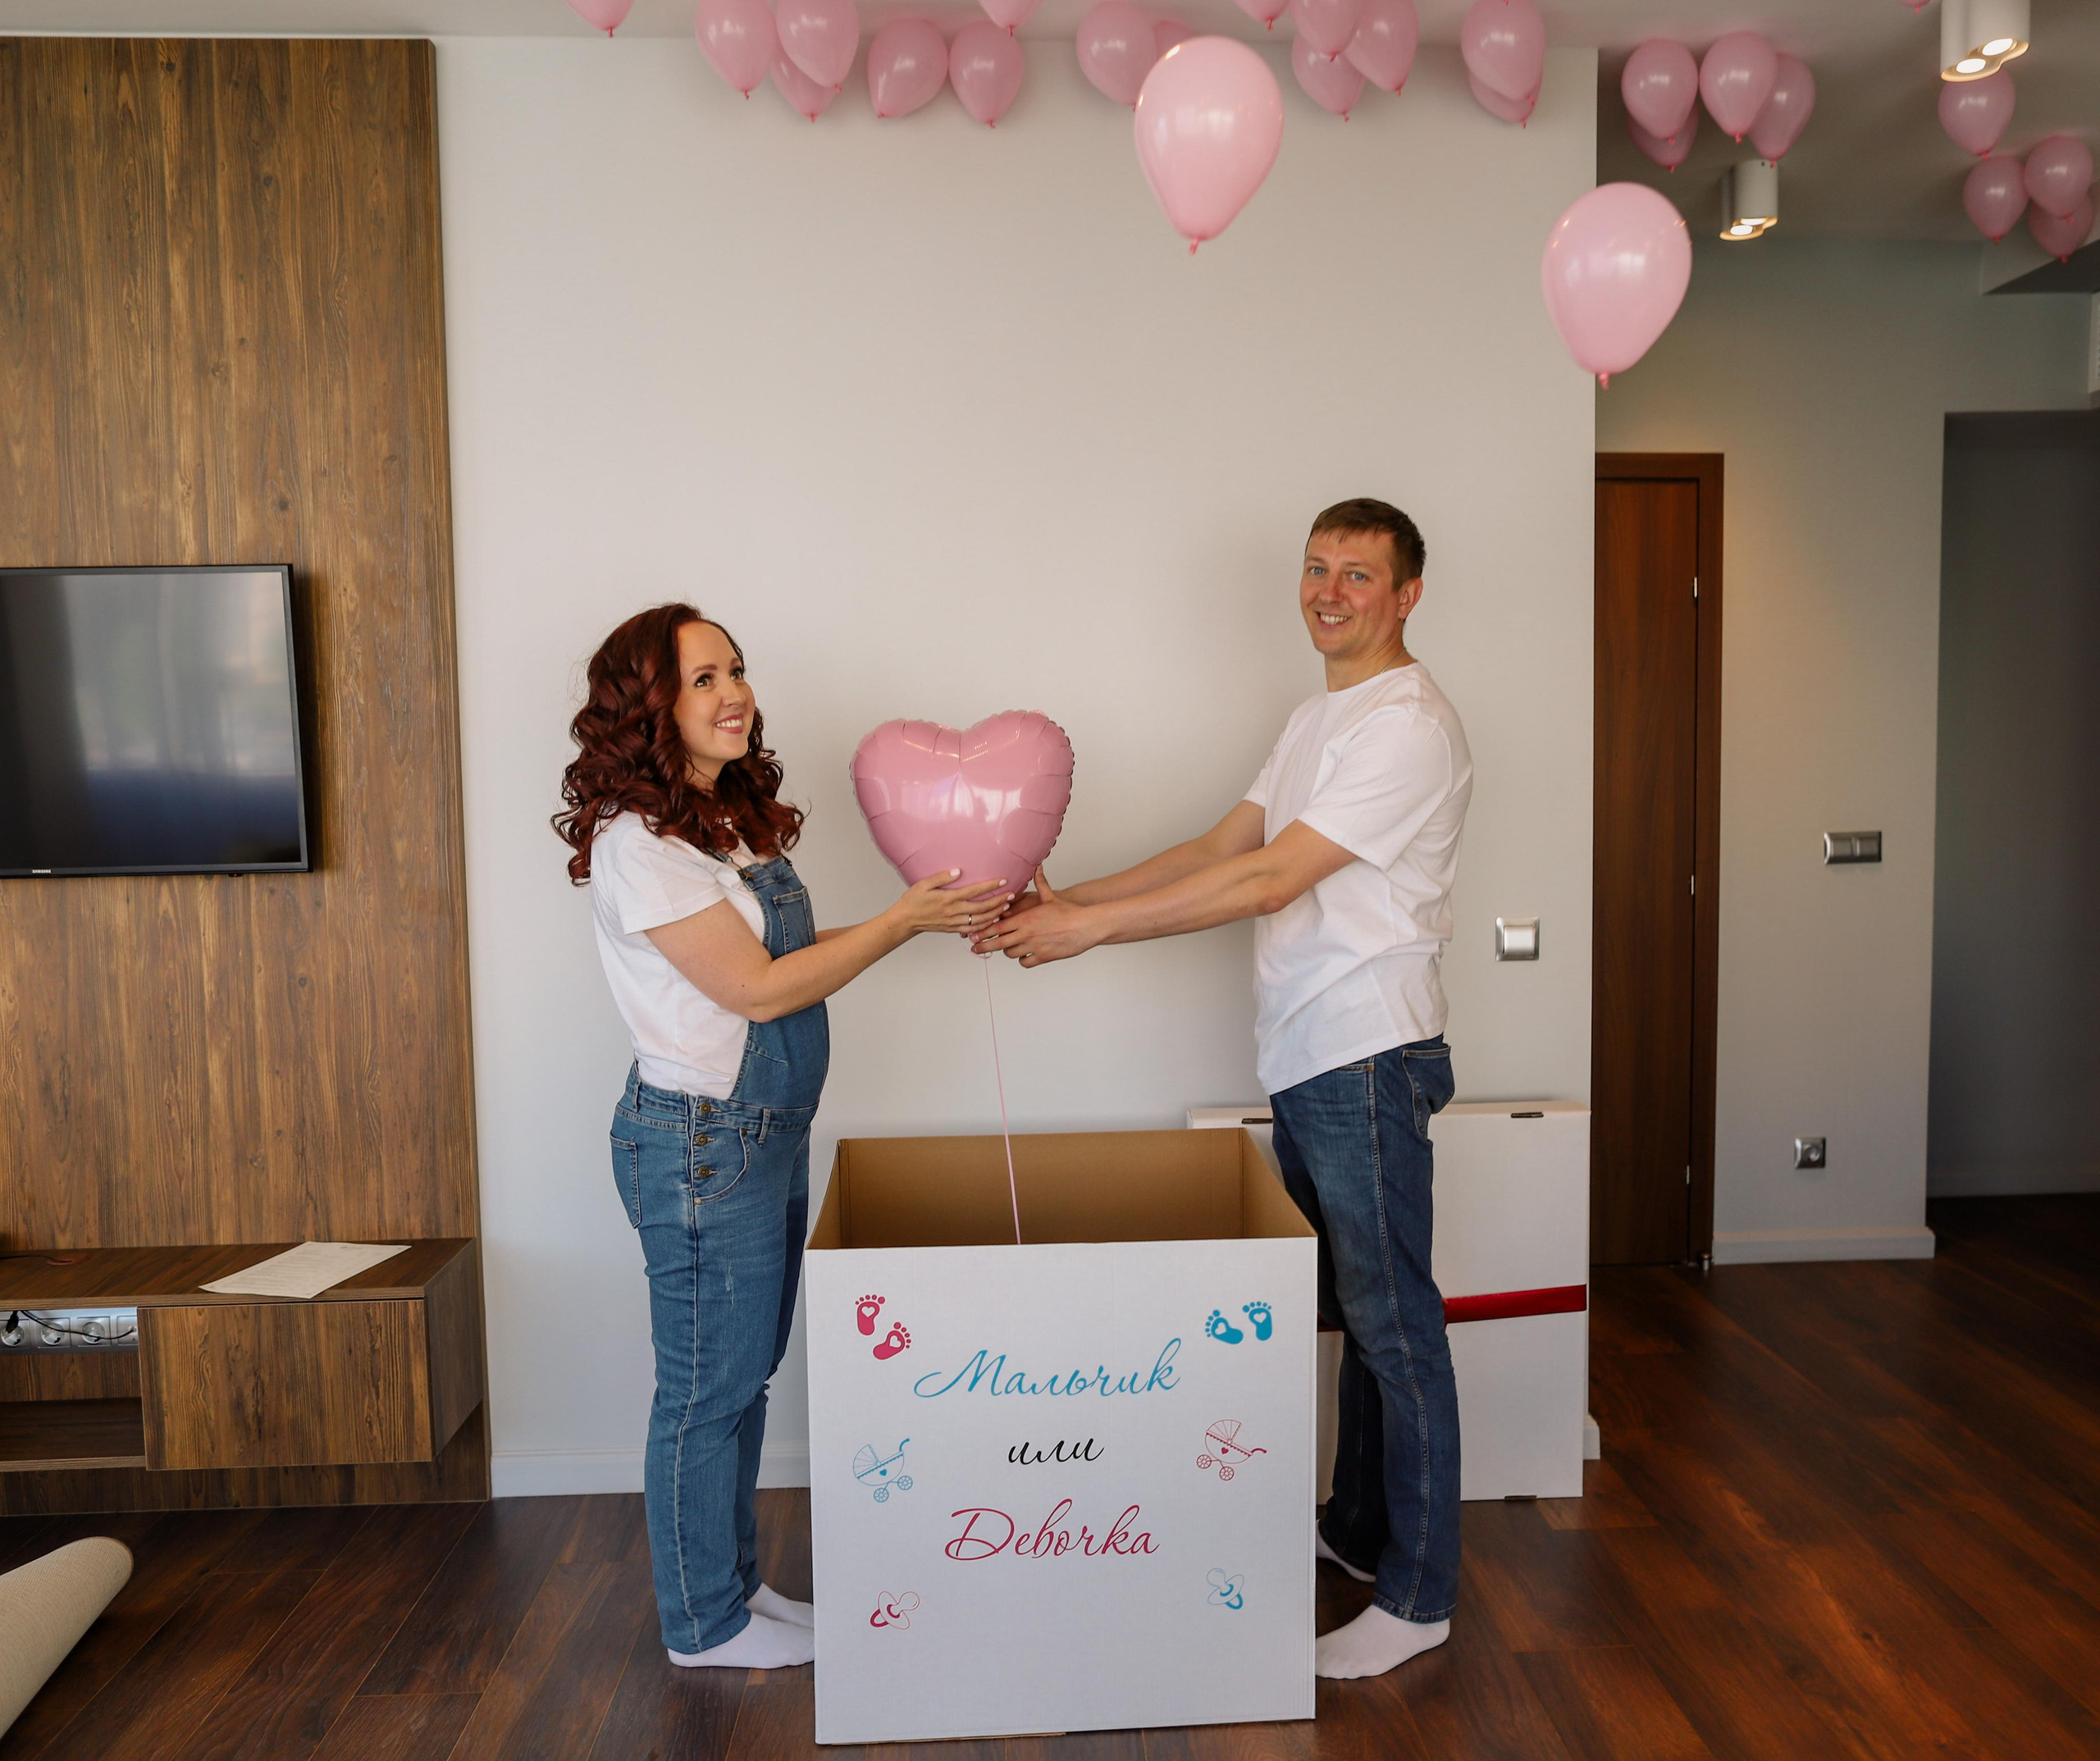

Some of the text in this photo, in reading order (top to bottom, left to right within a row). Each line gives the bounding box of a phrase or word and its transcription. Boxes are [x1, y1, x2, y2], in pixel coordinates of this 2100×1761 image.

[914, 1338, 1182, 1398] Мальчик
[1007, 1437, 1105, 1466] или
[944, 1499, 1160, 1561] Девочка
